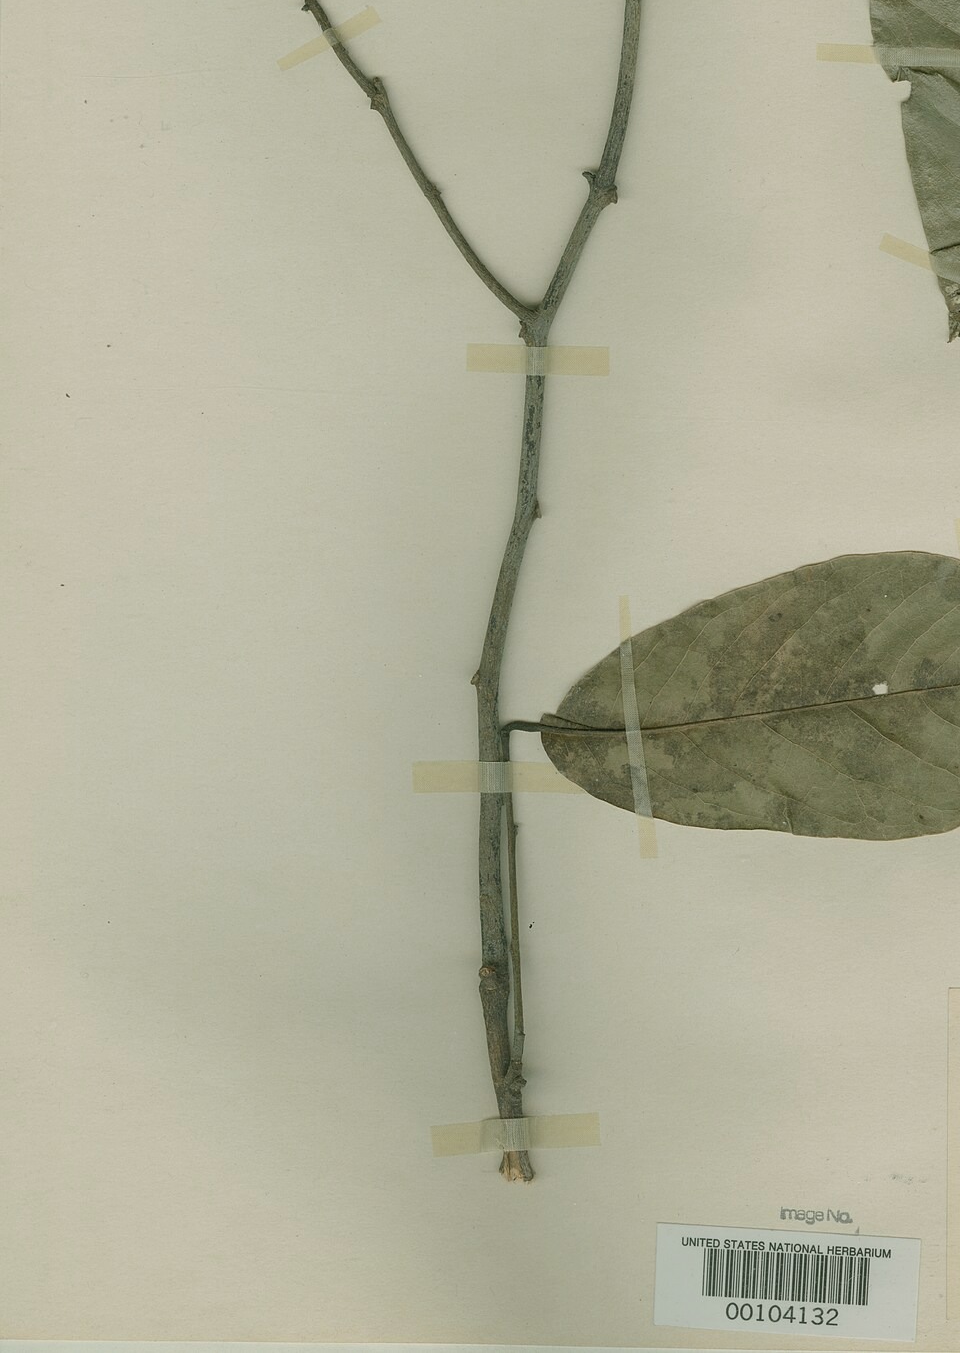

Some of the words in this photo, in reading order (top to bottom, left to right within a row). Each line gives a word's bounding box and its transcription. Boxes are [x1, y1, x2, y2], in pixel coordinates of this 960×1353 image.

[780, 1206, 824, 1224] Image
[681, 1237, 720, 1248] UNITED
[723, 1239, 765, 1251] STATES
[769, 1242, 823, 1255] NATIONAL
[827, 1245, 892, 1259] HERBARIUM
[725, 1302, 839, 1326] 00104132
